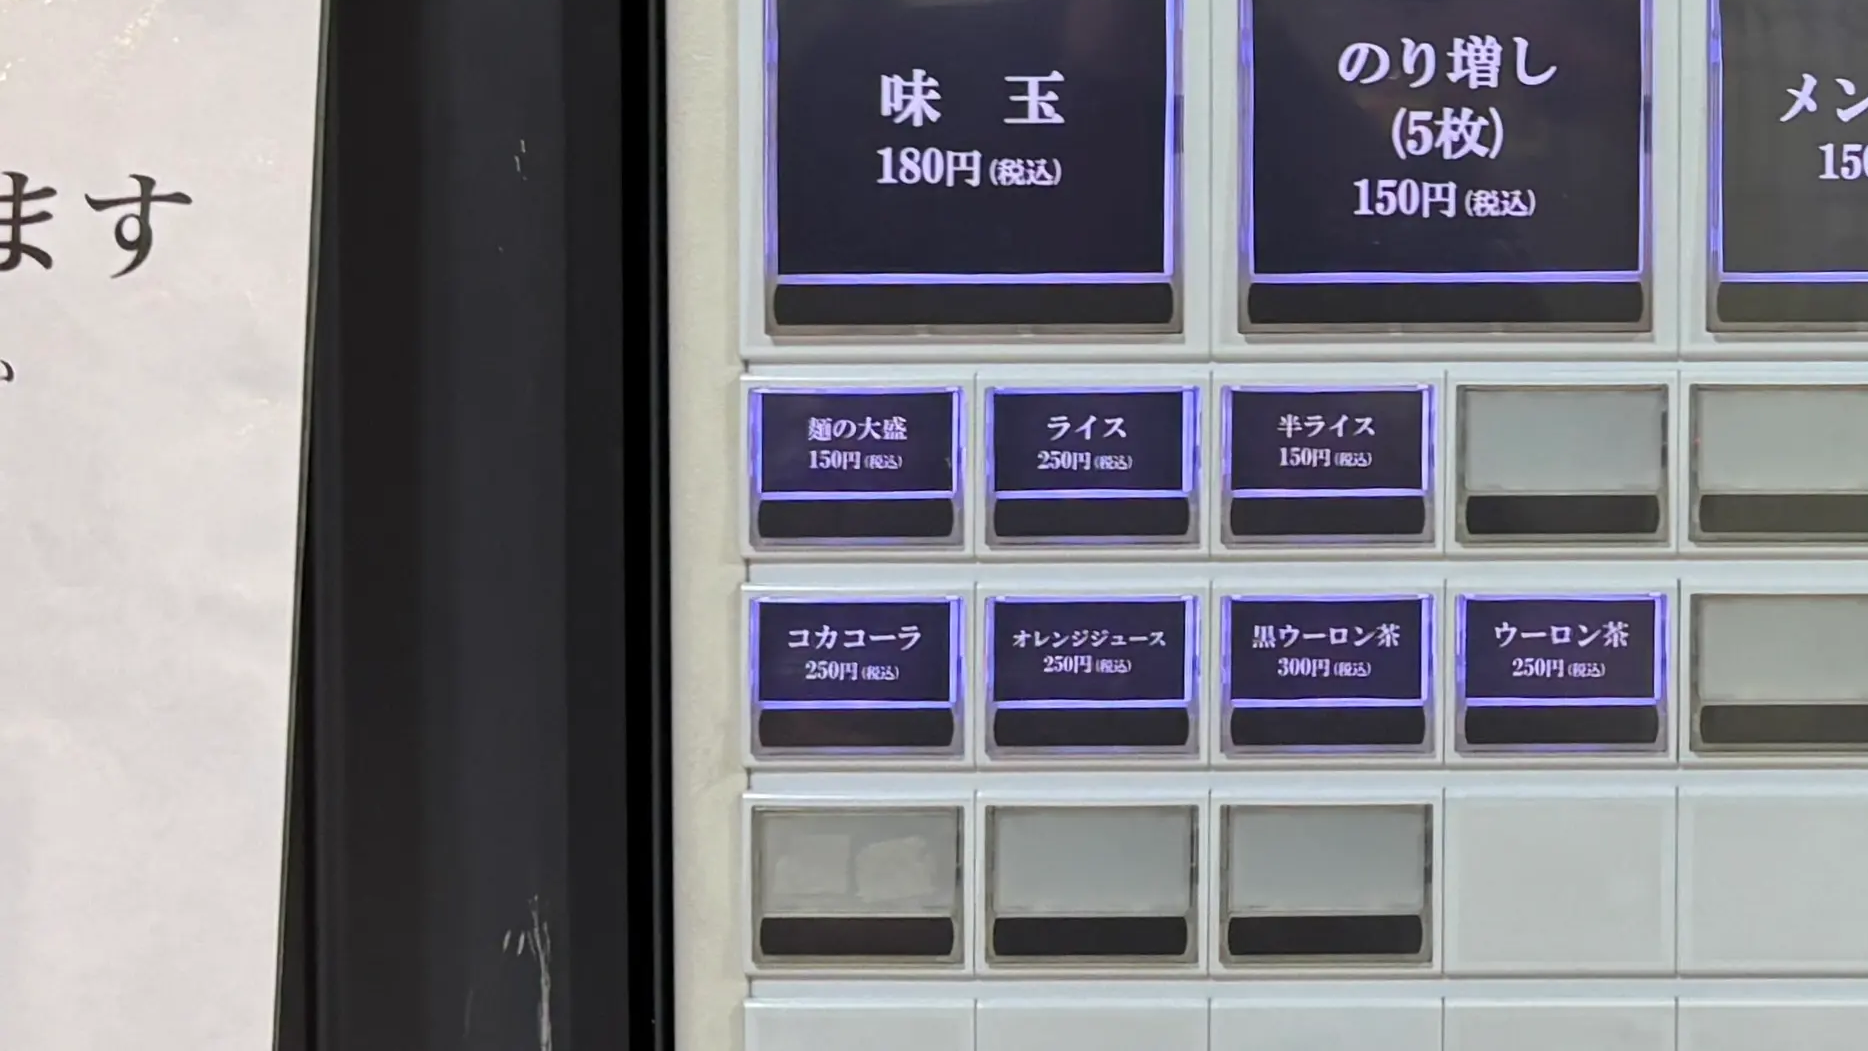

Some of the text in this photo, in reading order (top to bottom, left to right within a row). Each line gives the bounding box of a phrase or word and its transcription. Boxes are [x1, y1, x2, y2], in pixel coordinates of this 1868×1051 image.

[1338, 35, 1557, 89] のり増し
[1391, 107, 1503, 160] (5枚)
[1047, 415, 1128, 440] ライス
[1277, 414, 1376, 438] 半ライス
[787, 625, 922, 651] コカコーラ
[1012, 629, 1167, 648] オレンジジュース
[1252, 623, 1401, 649] 黒ウーロン茶
[1494, 621, 1630, 648] ウーロン茶
